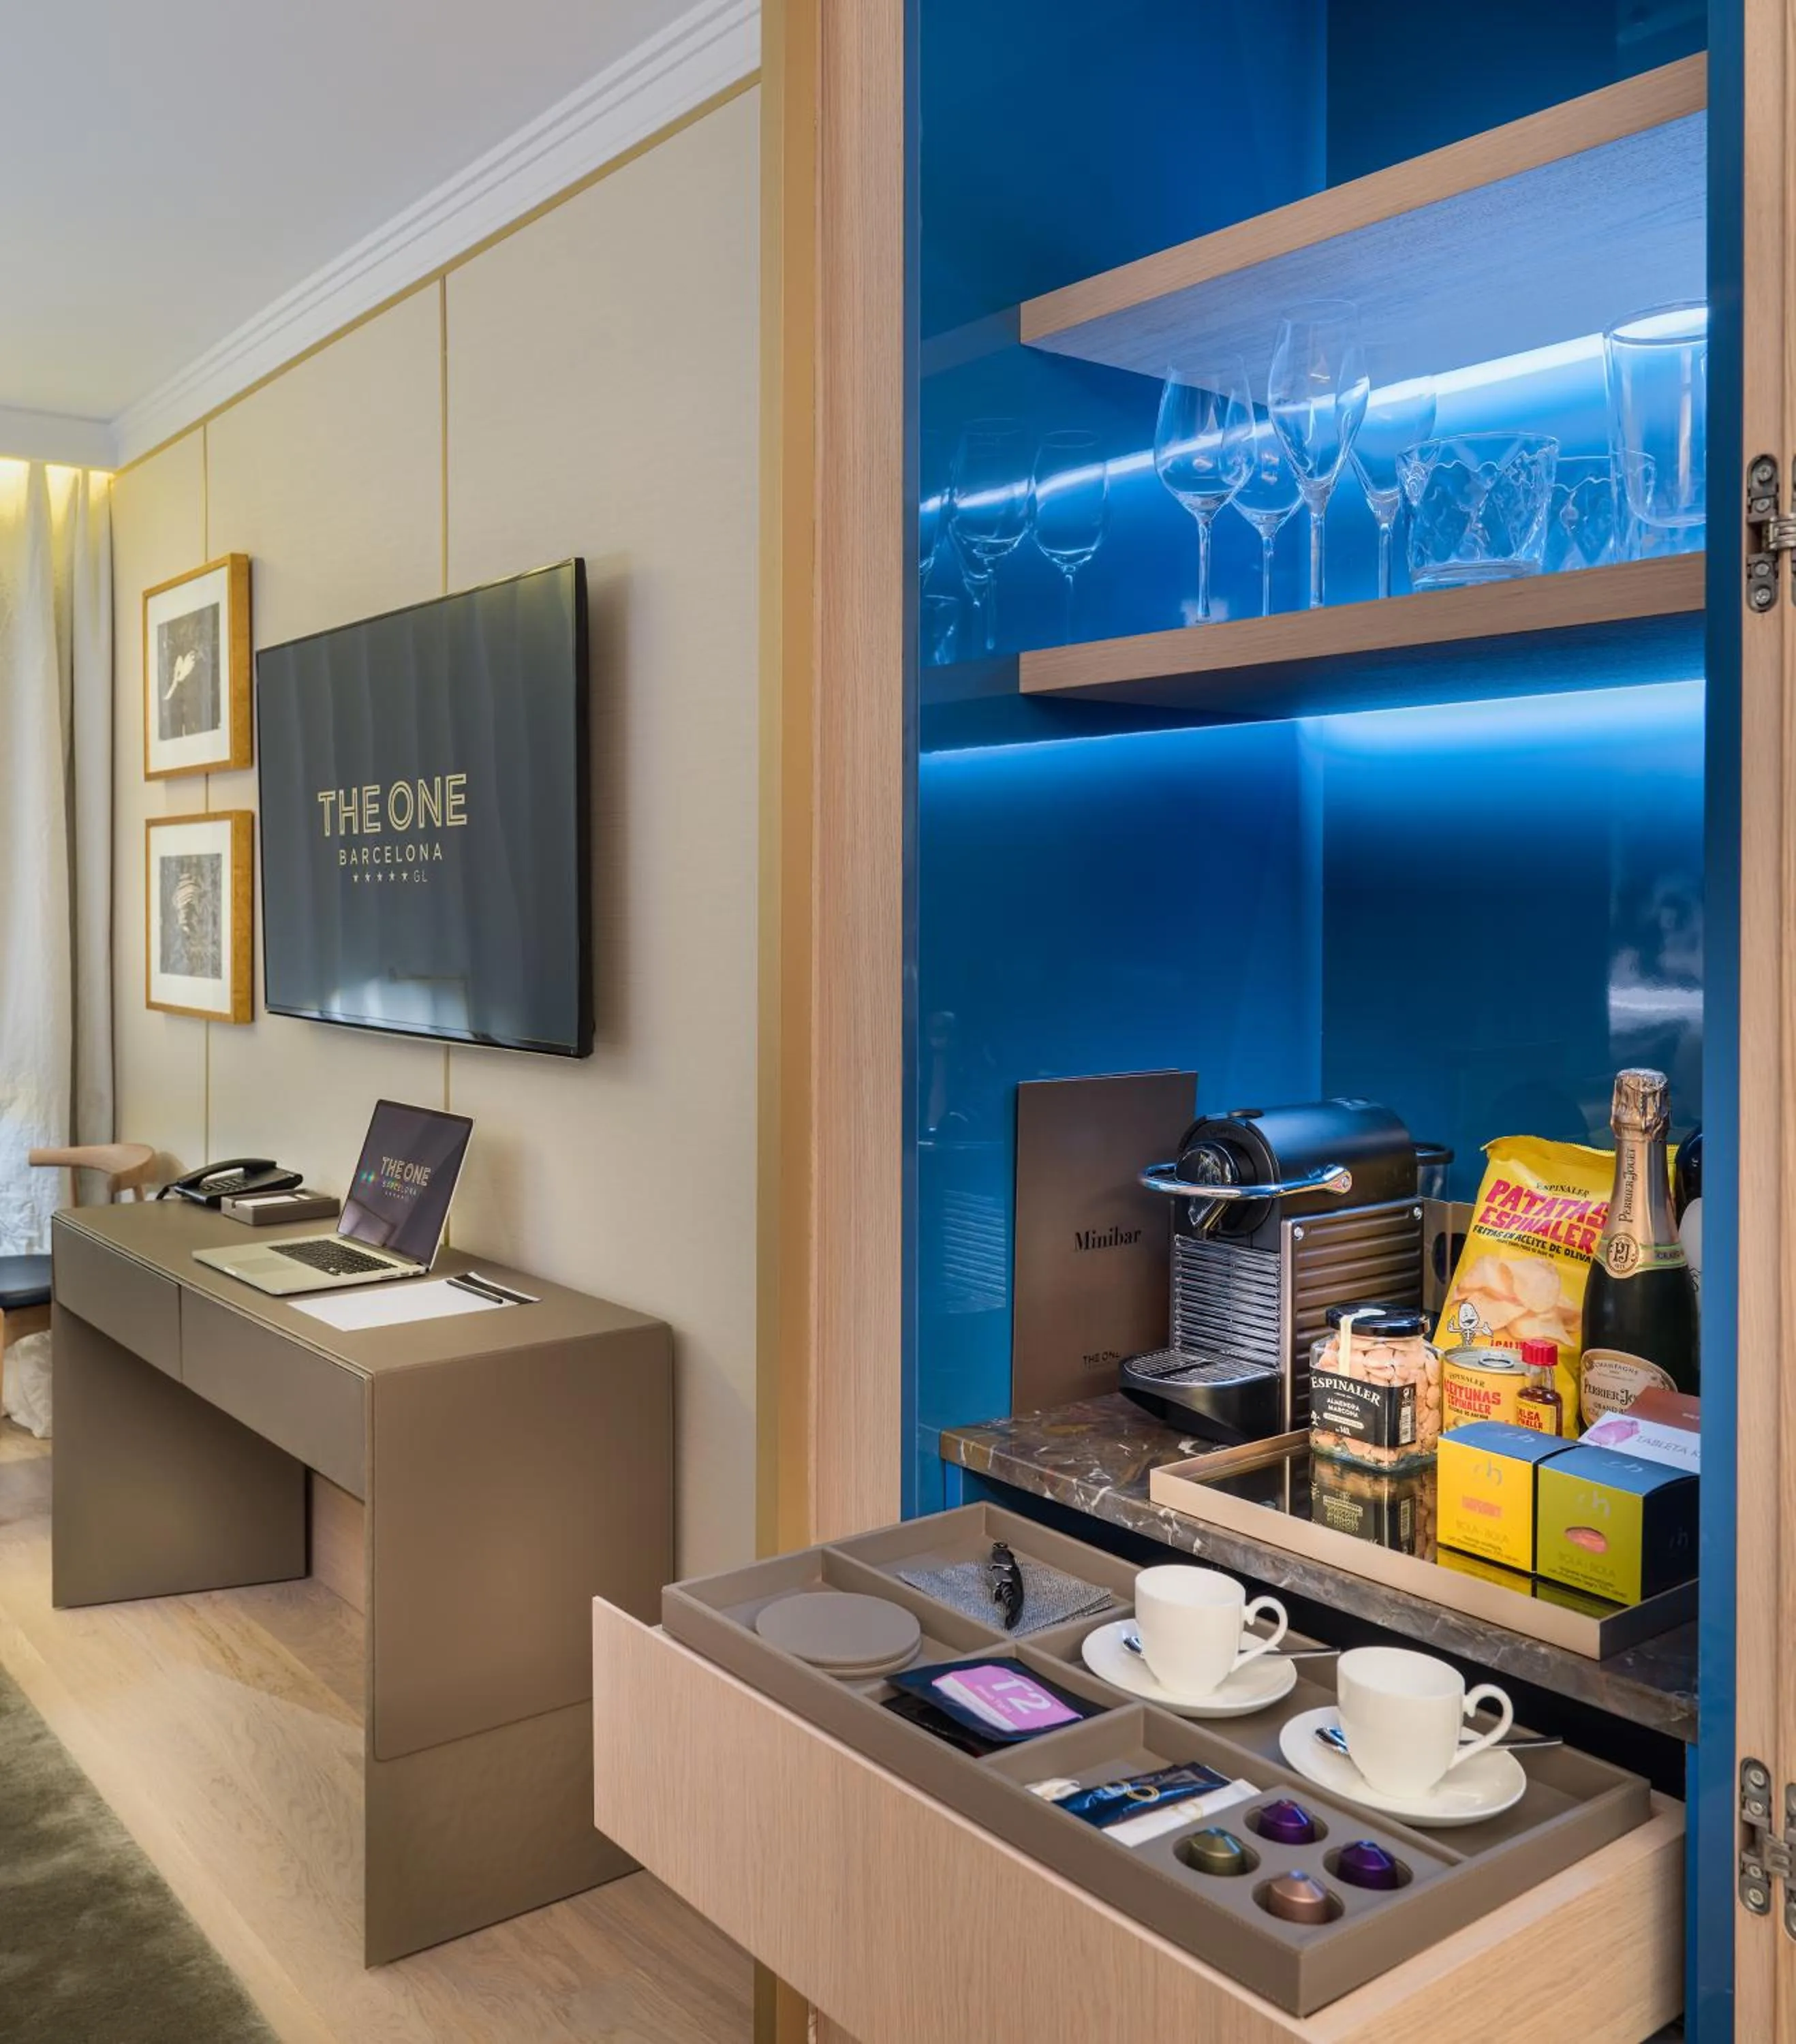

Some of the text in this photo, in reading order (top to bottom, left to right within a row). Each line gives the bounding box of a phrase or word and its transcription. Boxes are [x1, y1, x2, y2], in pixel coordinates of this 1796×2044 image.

[318, 773, 468, 837] THE ONE
[339, 842, 443, 866] BARCELONA
[381, 1156, 431, 1186] THE ONE
[1485, 1179, 1609, 1229] PATATAS
[1074, 1226, 1142, 1252] Minibar
[1478, 1205, 1596, 1254] ESPINALER
[1515, 1234, 1547, 1252] ACEITE
[1549, 1243, 1562, 1254] DE
[1564, 1248, 1591, 1263] OLIVA
[1083, 1353, 1100, 1364] THE
[1311, 1376, 1381, 1407] ESPINALER
[1637, 1435, 1687, 1455] TABLETA
[991, 1675, 1051, 1714] T2
